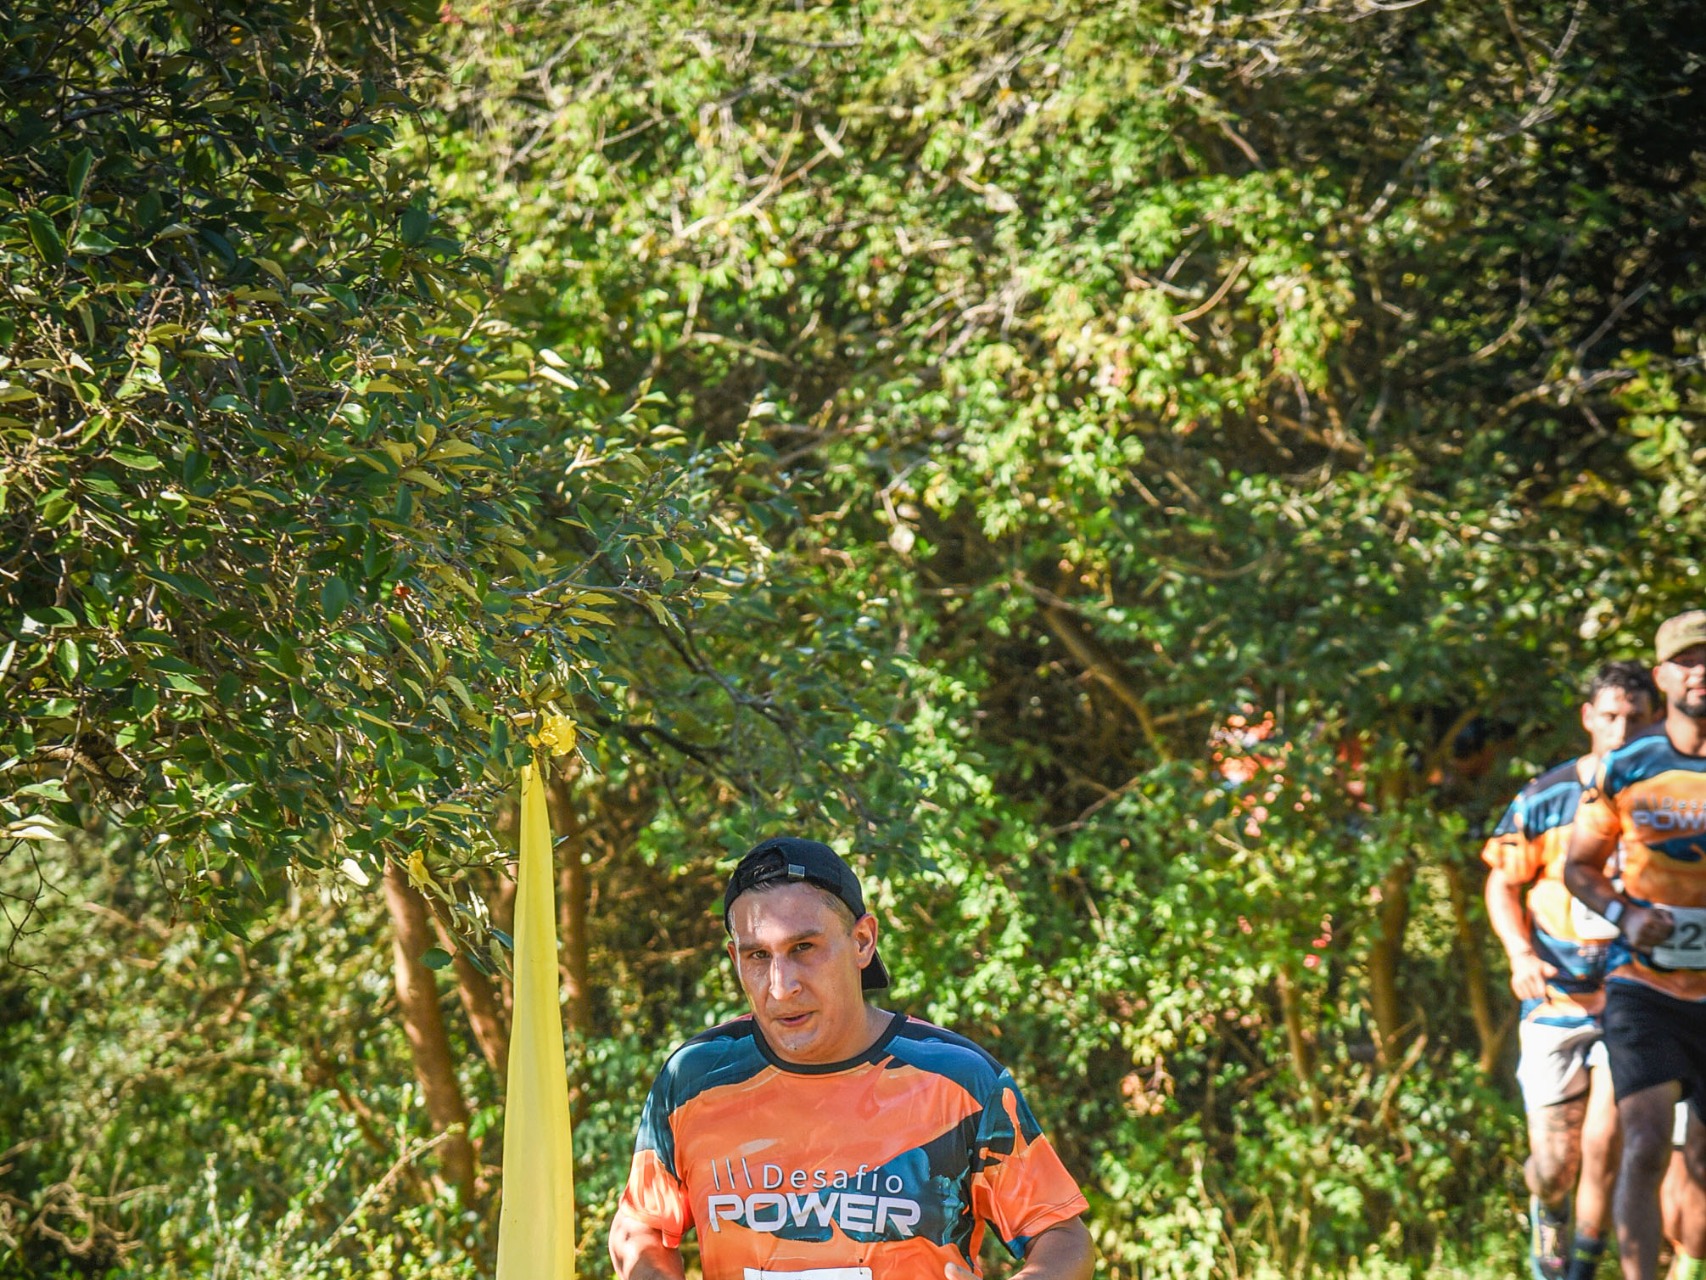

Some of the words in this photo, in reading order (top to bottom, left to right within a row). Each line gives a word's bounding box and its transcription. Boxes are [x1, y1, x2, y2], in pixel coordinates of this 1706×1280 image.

[1632, 810, 1706, 830] POW
[763, 1164, 904, 1194] Desafío
[708, 1192, 921, 1236] POWER
